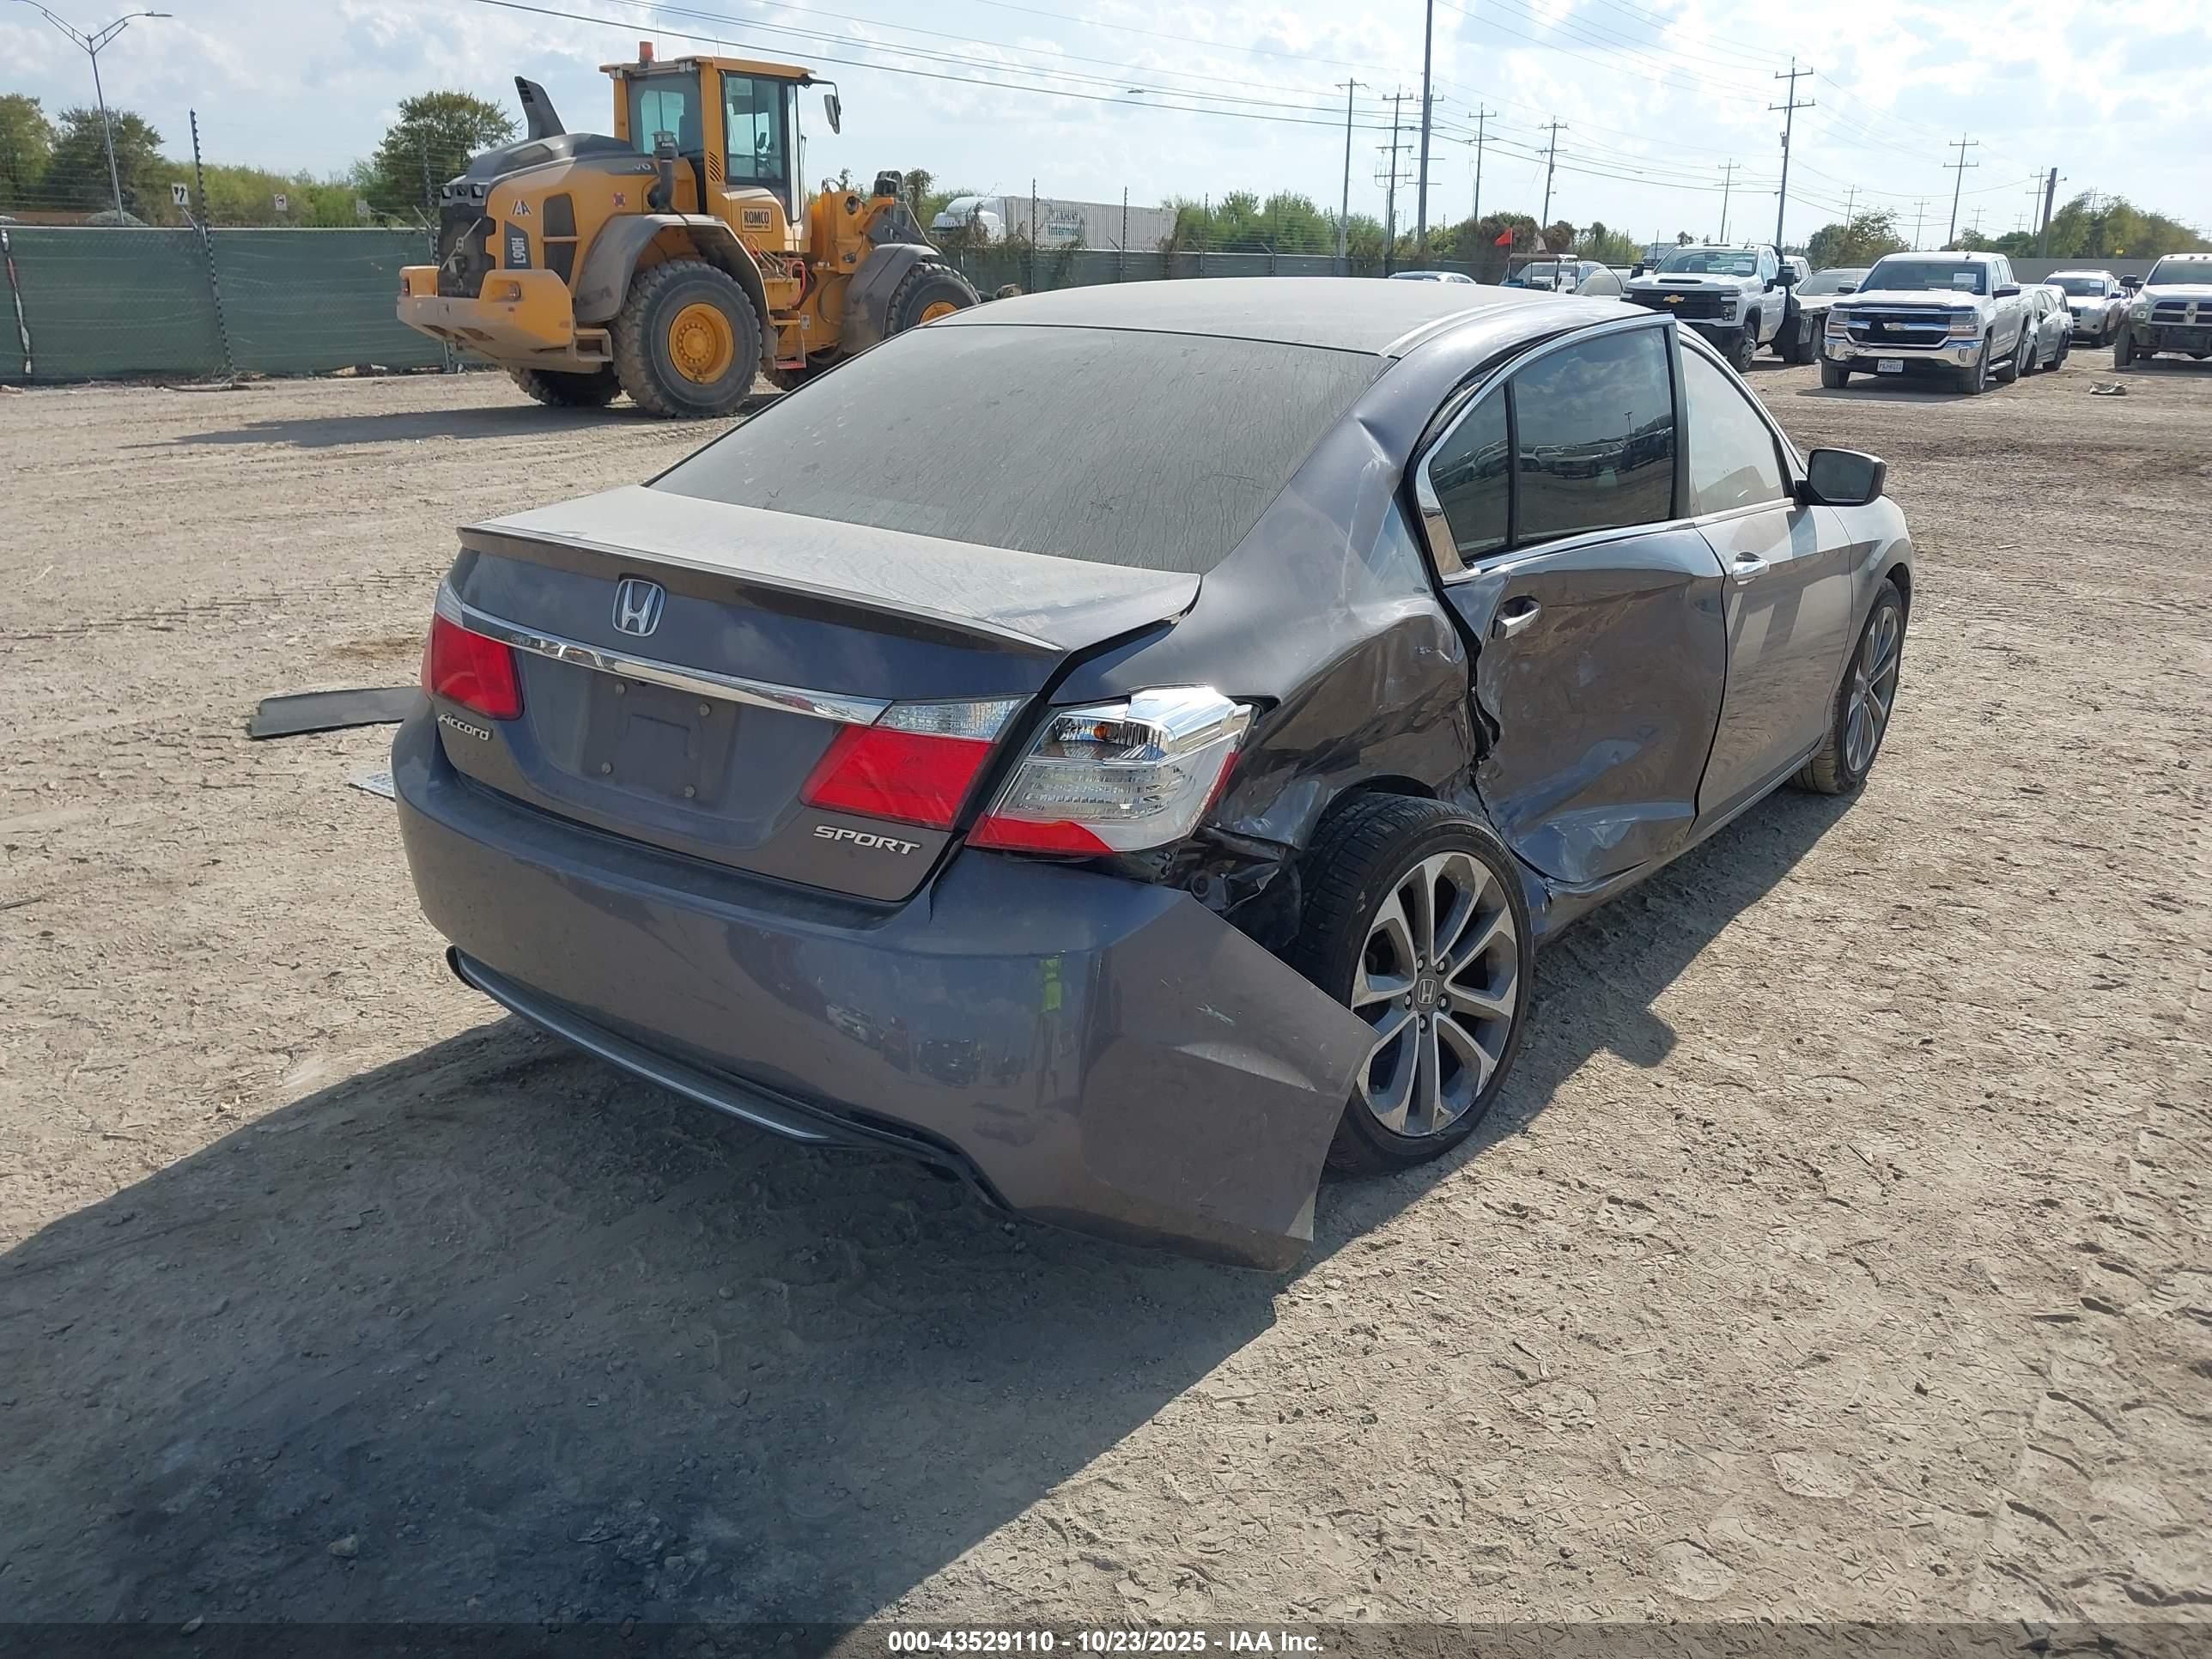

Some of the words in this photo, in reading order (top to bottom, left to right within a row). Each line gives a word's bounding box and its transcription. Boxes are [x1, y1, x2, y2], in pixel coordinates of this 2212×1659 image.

[744, 211, 770, 224] ROMCO
[511, 237, 526, 264] L90H
[437, 714, 490, 741] Accord
[812, 825, 921, 855] SPORT
